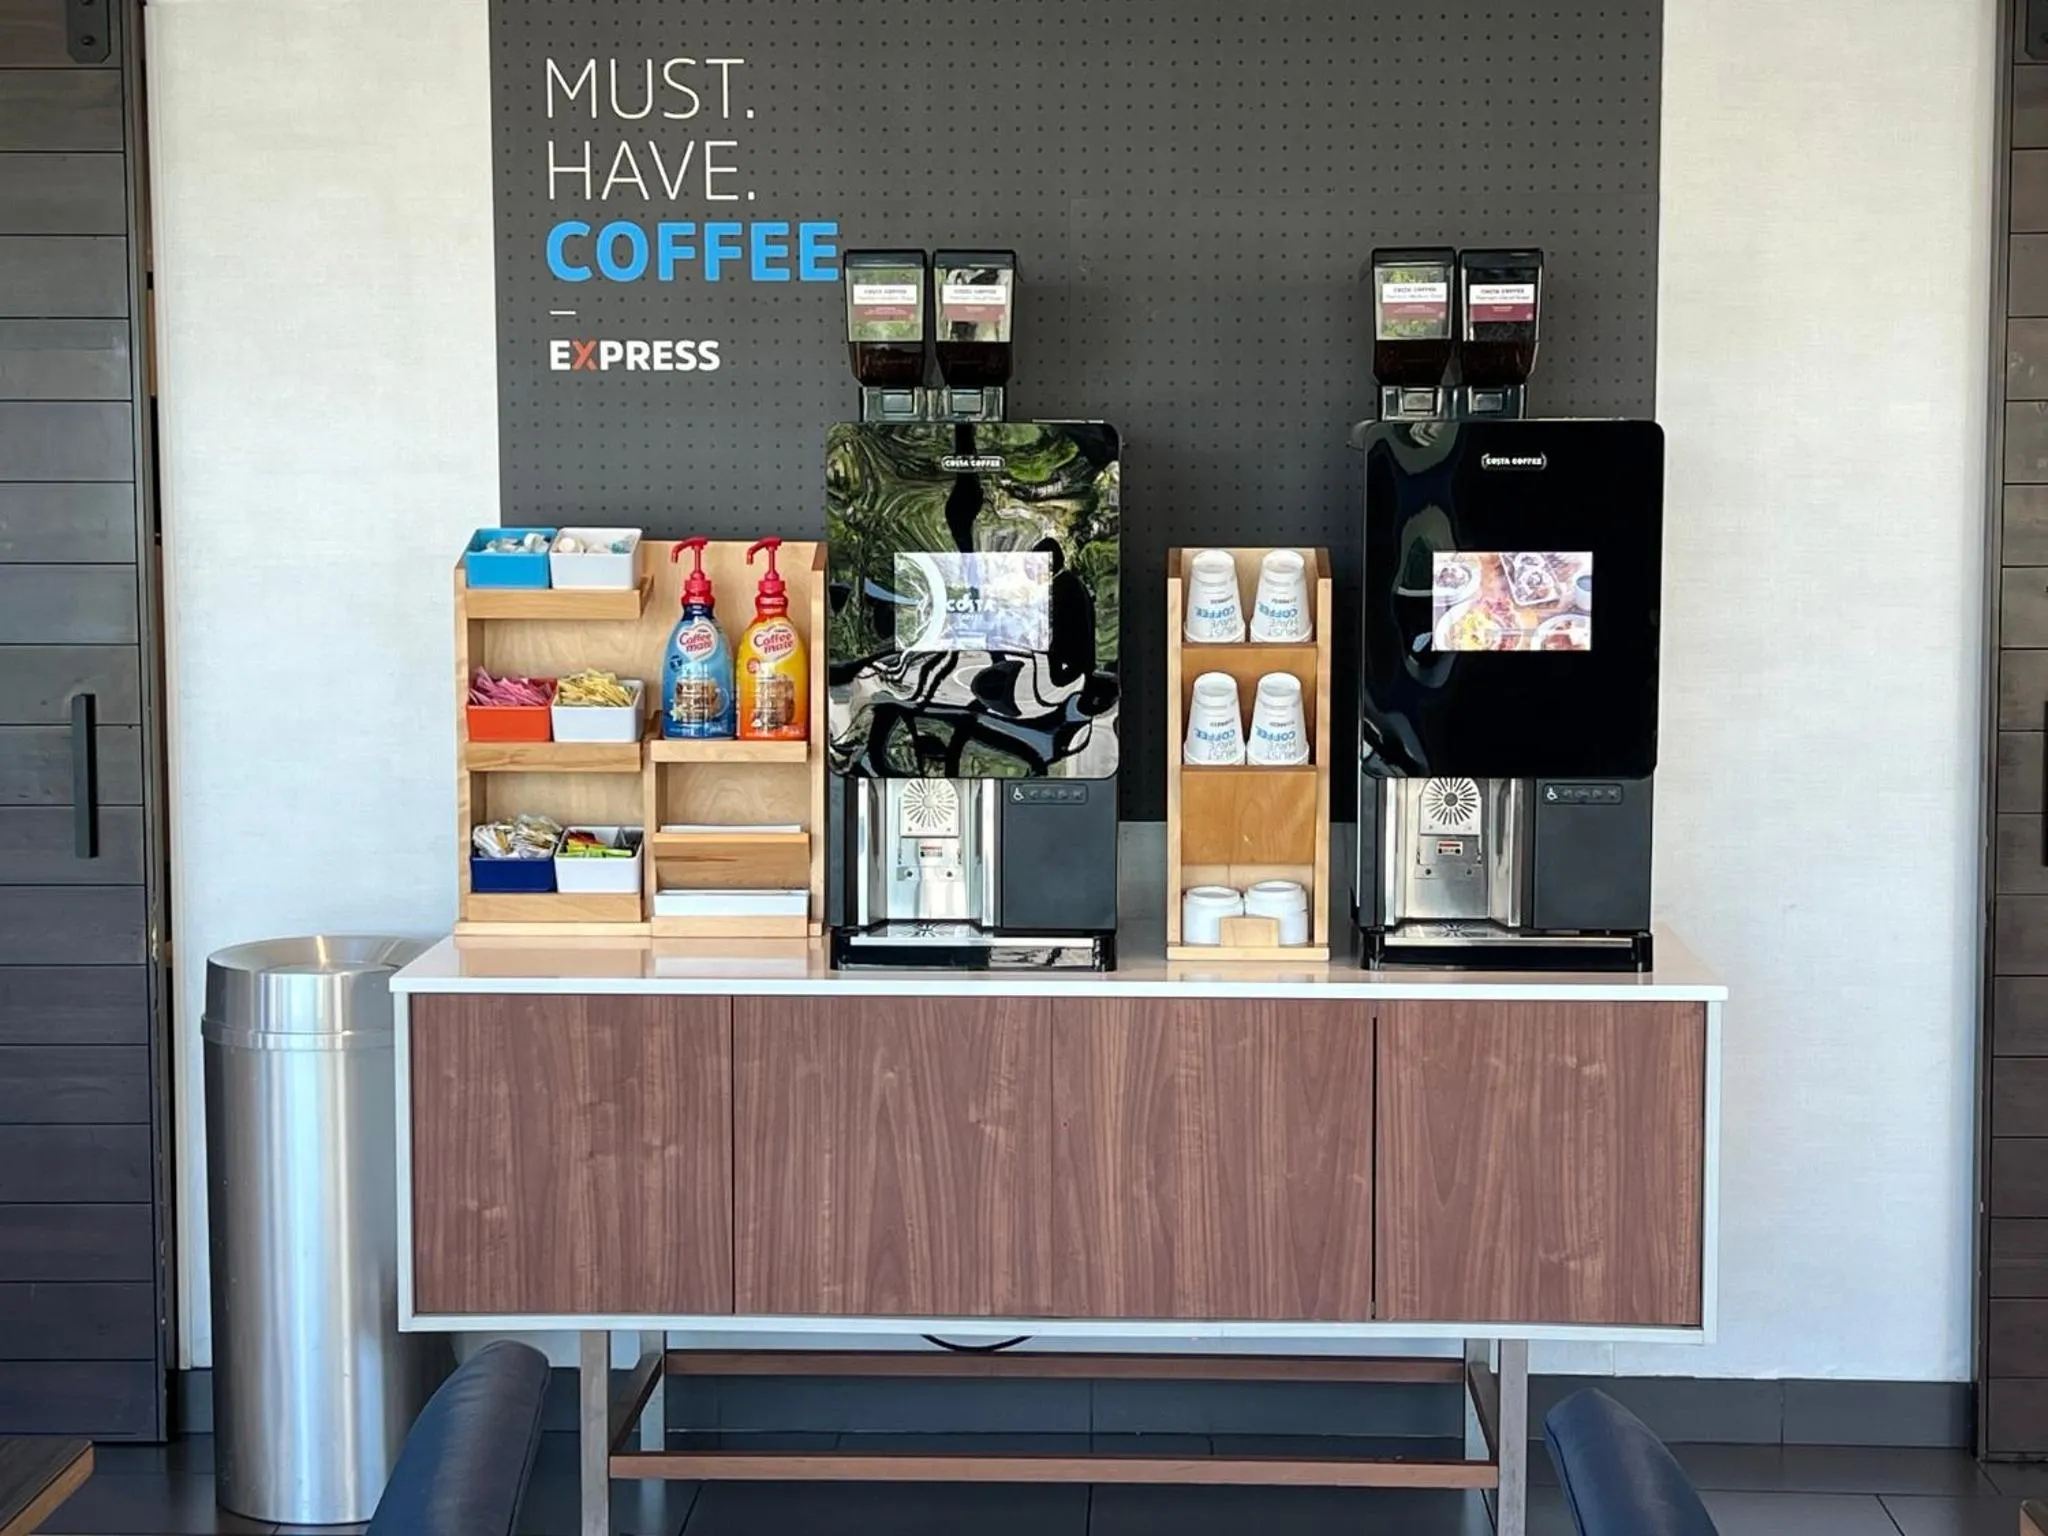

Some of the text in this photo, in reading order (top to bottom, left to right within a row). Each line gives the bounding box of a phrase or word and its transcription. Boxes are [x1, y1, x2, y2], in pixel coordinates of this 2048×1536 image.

[546, 58, 755, 119] MUST.
[548, 140, 756, 200] HAVE.
[546, 220, 839, 282] COFFEE
[549, 340, 720, 371] EXPRESS
[945, 459, 1001, 467] COSTA COFFEE
[1486, 457, 1542, 465] COSTA COFFEE
[679, 631, 711, 647] Coffee
[754, 632, 793, 648] Coffee
[764, 640, 795, 654] mate
